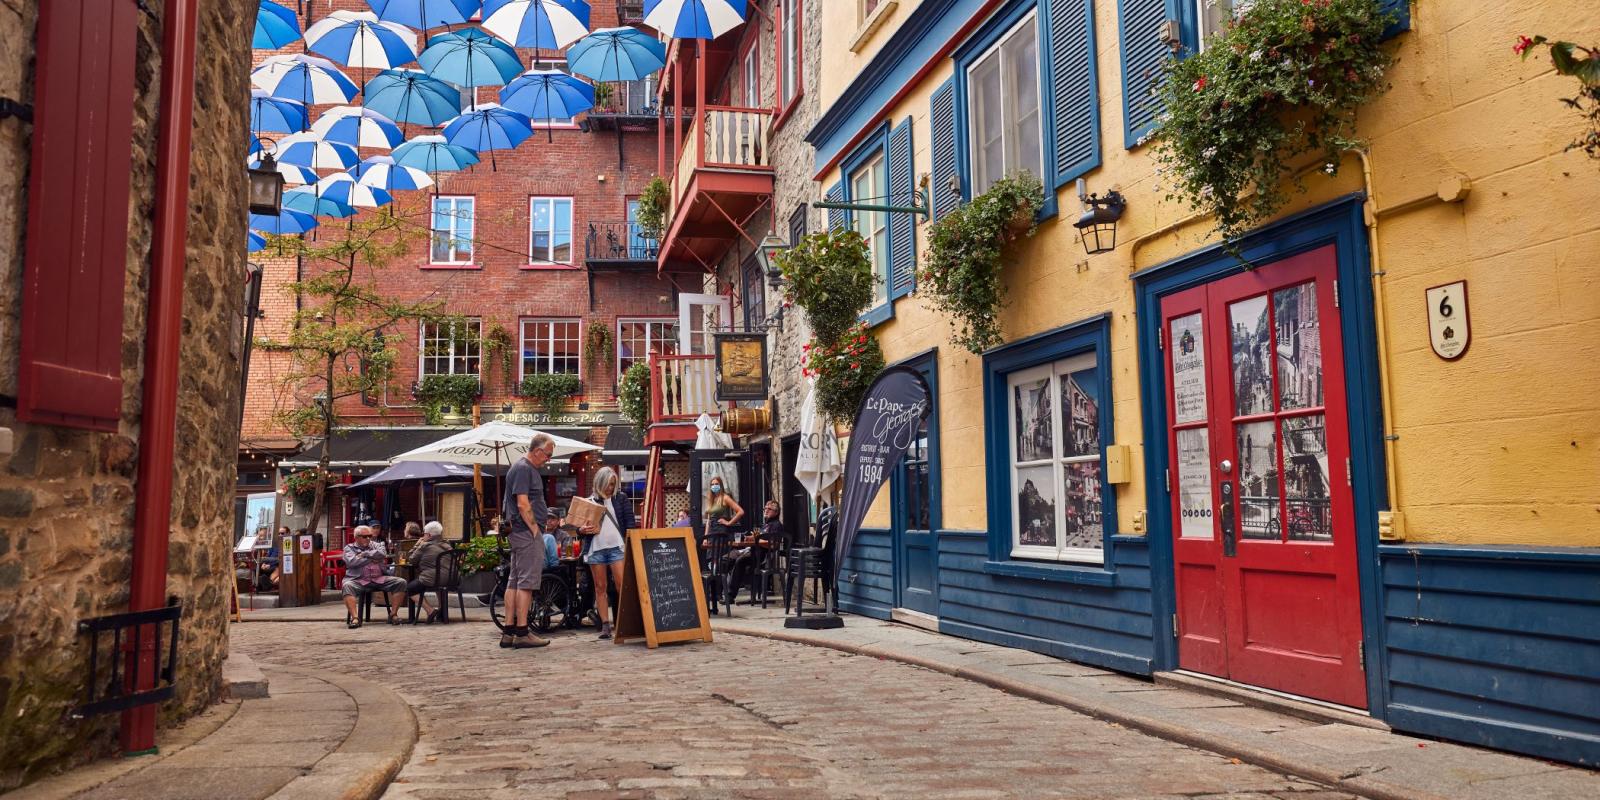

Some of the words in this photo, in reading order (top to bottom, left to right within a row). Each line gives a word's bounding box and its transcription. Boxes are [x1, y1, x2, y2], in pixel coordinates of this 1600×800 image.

[1440, 296, 1452, 318] 6
[872, 399, 927, 450] Georges
[860, 464, 883, 485] 1984
